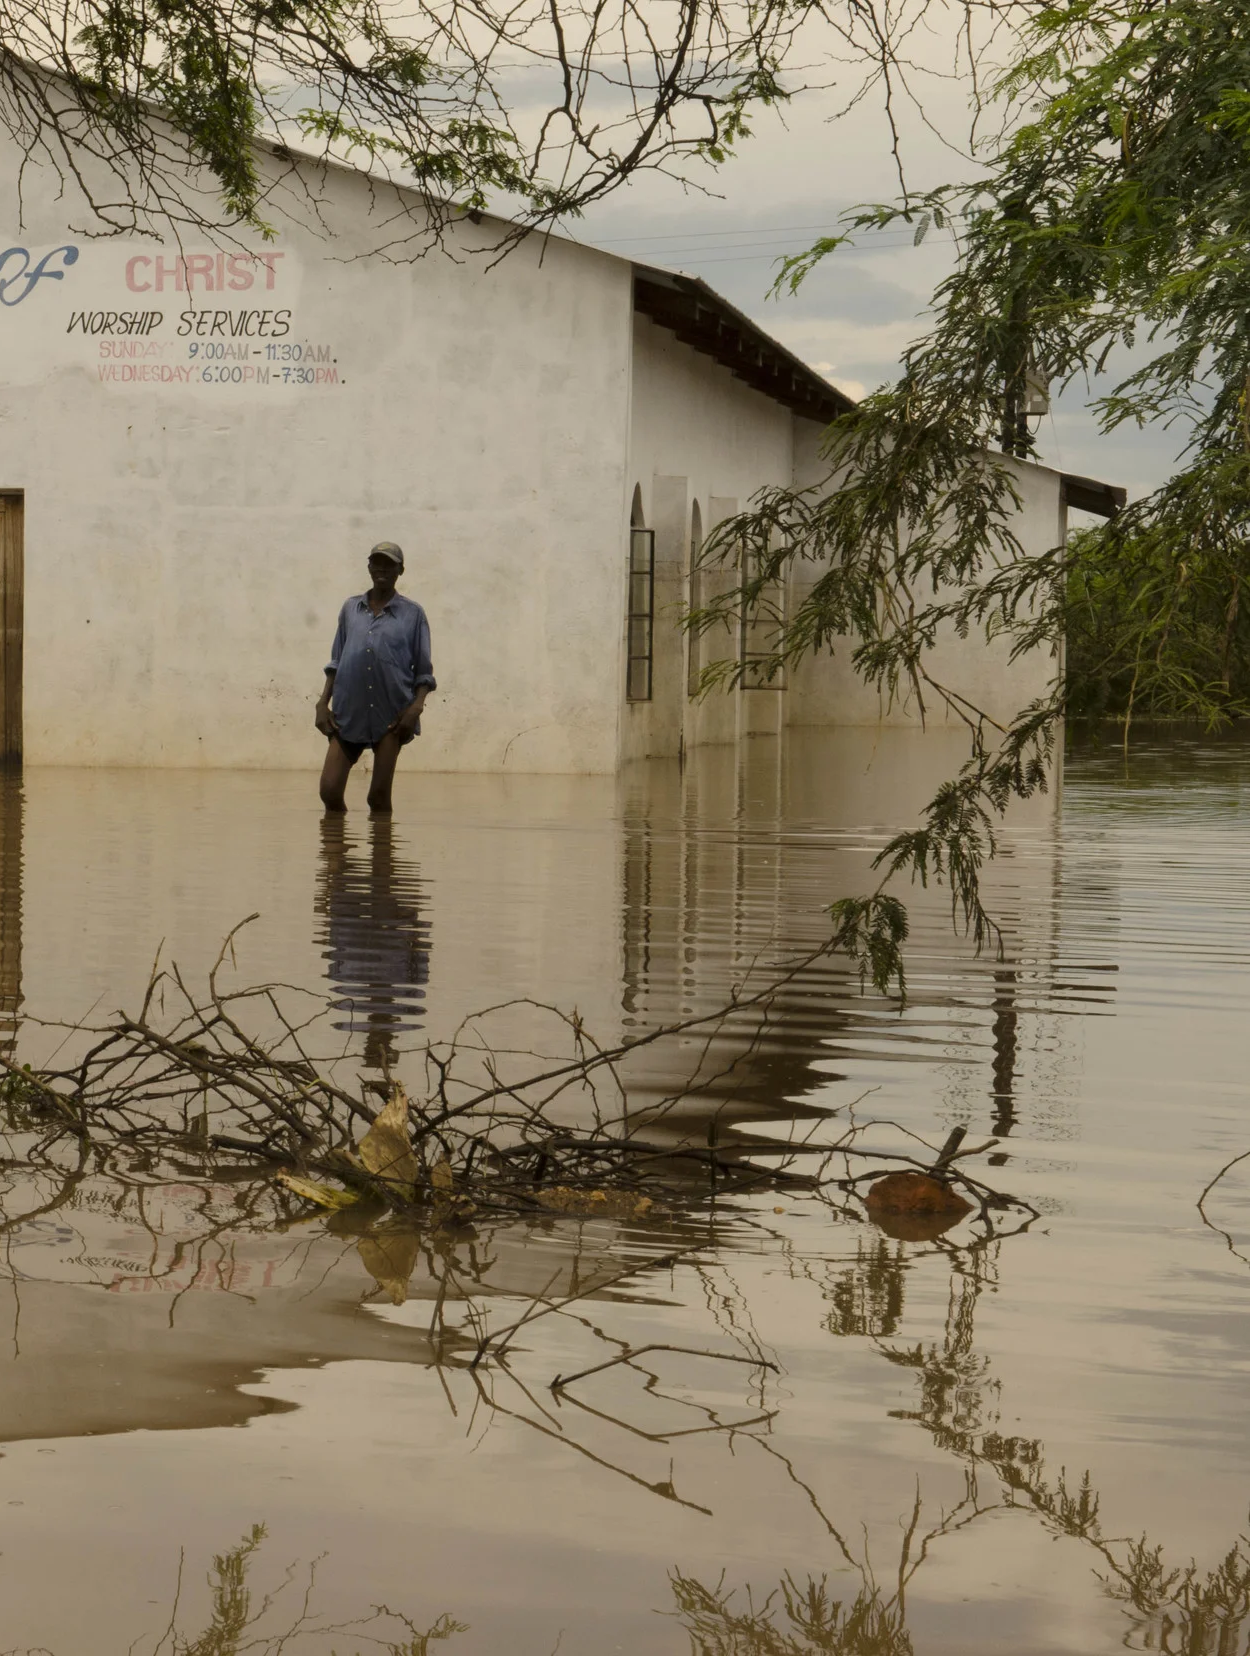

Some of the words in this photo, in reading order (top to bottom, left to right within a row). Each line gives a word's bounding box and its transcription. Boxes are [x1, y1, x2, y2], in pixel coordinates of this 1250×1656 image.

[124, 252, 285, 293] CHRIST
[66, 311, 163, 336] WORSHIP
[177, 309, 292, 337] SERVICES
